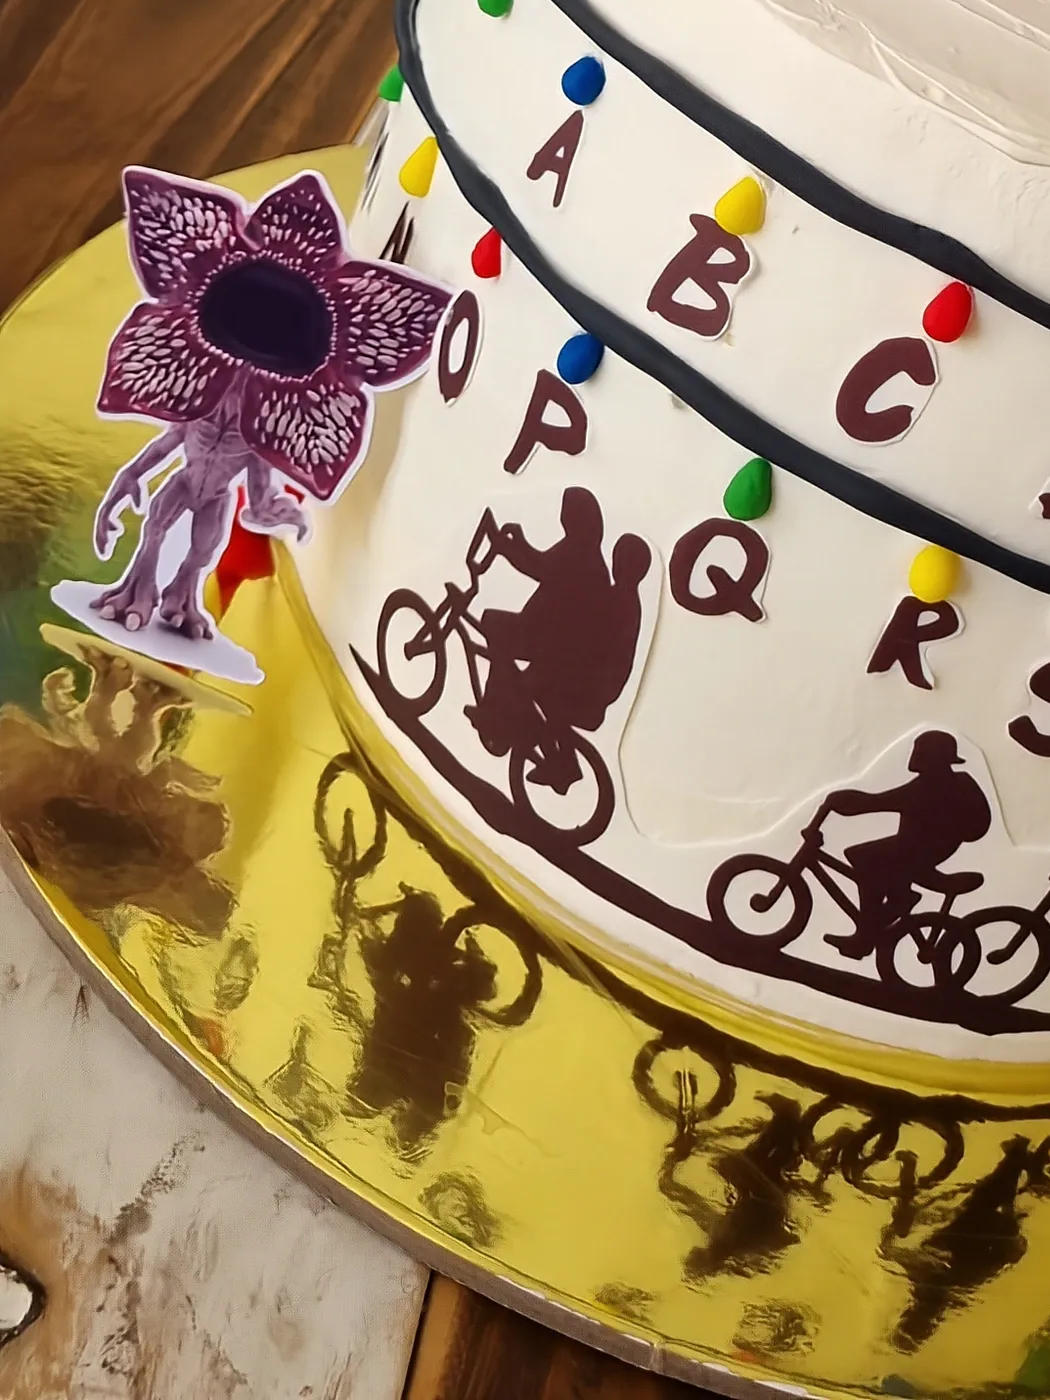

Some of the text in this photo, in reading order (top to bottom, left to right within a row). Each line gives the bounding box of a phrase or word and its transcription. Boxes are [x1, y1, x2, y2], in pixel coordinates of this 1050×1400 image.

[526, 110, 584, 207] A
[647, 213, 751, 337] B
[836, 336, 938, 443] C
[503, 369, 588, 474] P
[669, 517, 770, 623] Q
[865, 596, 961, 691] R
